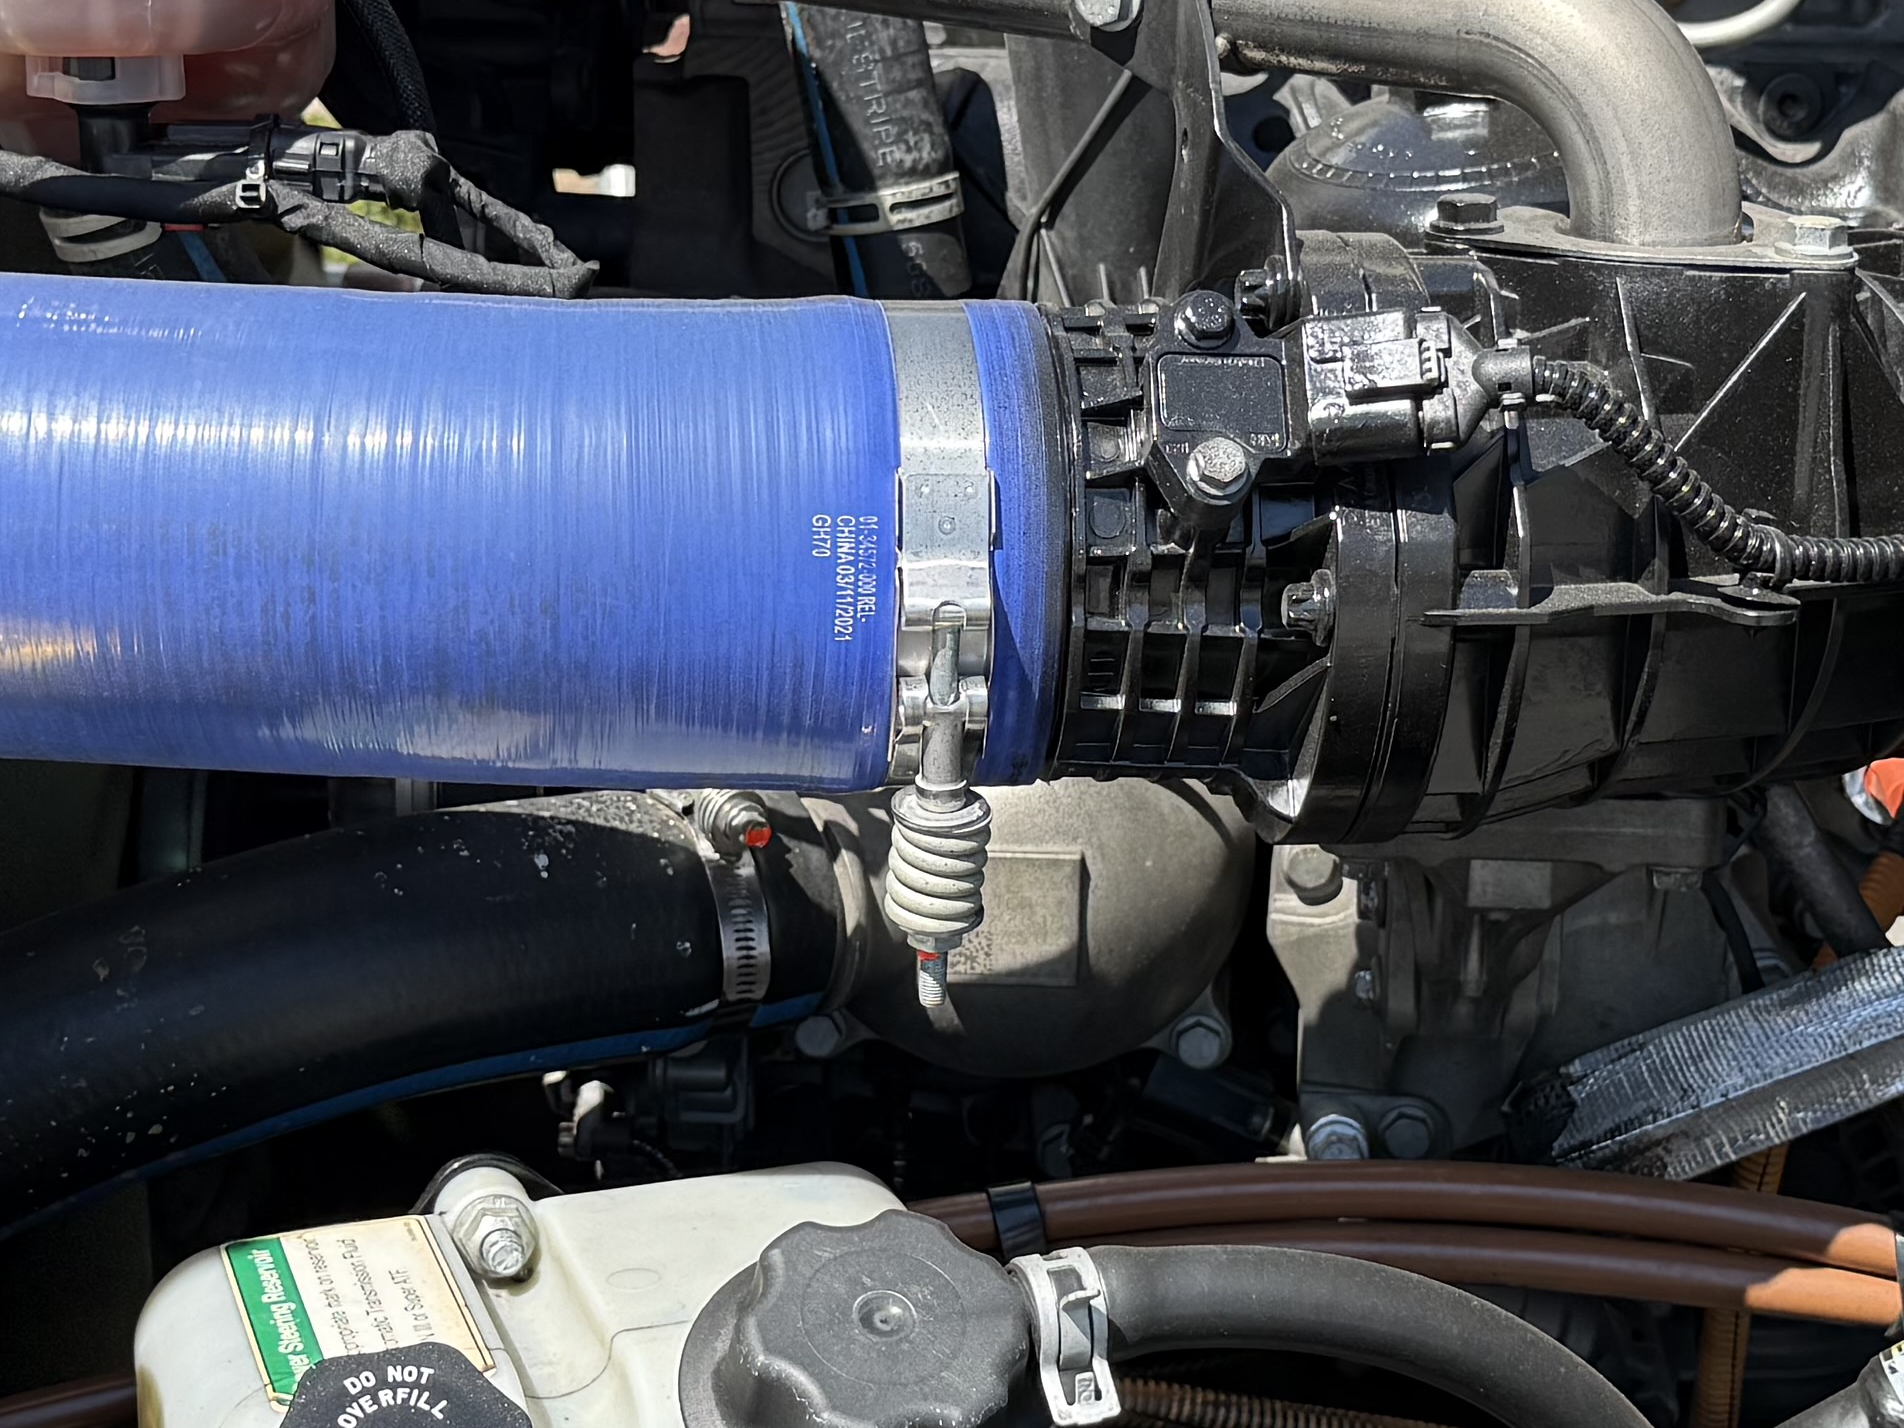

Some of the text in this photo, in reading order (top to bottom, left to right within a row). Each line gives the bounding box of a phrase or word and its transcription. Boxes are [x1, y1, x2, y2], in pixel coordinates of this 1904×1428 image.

[812, 514, 831, 558] GH70
[836, 515, 855, 564] CHINA
[343, 1365, 435, 1396] DO NOT
